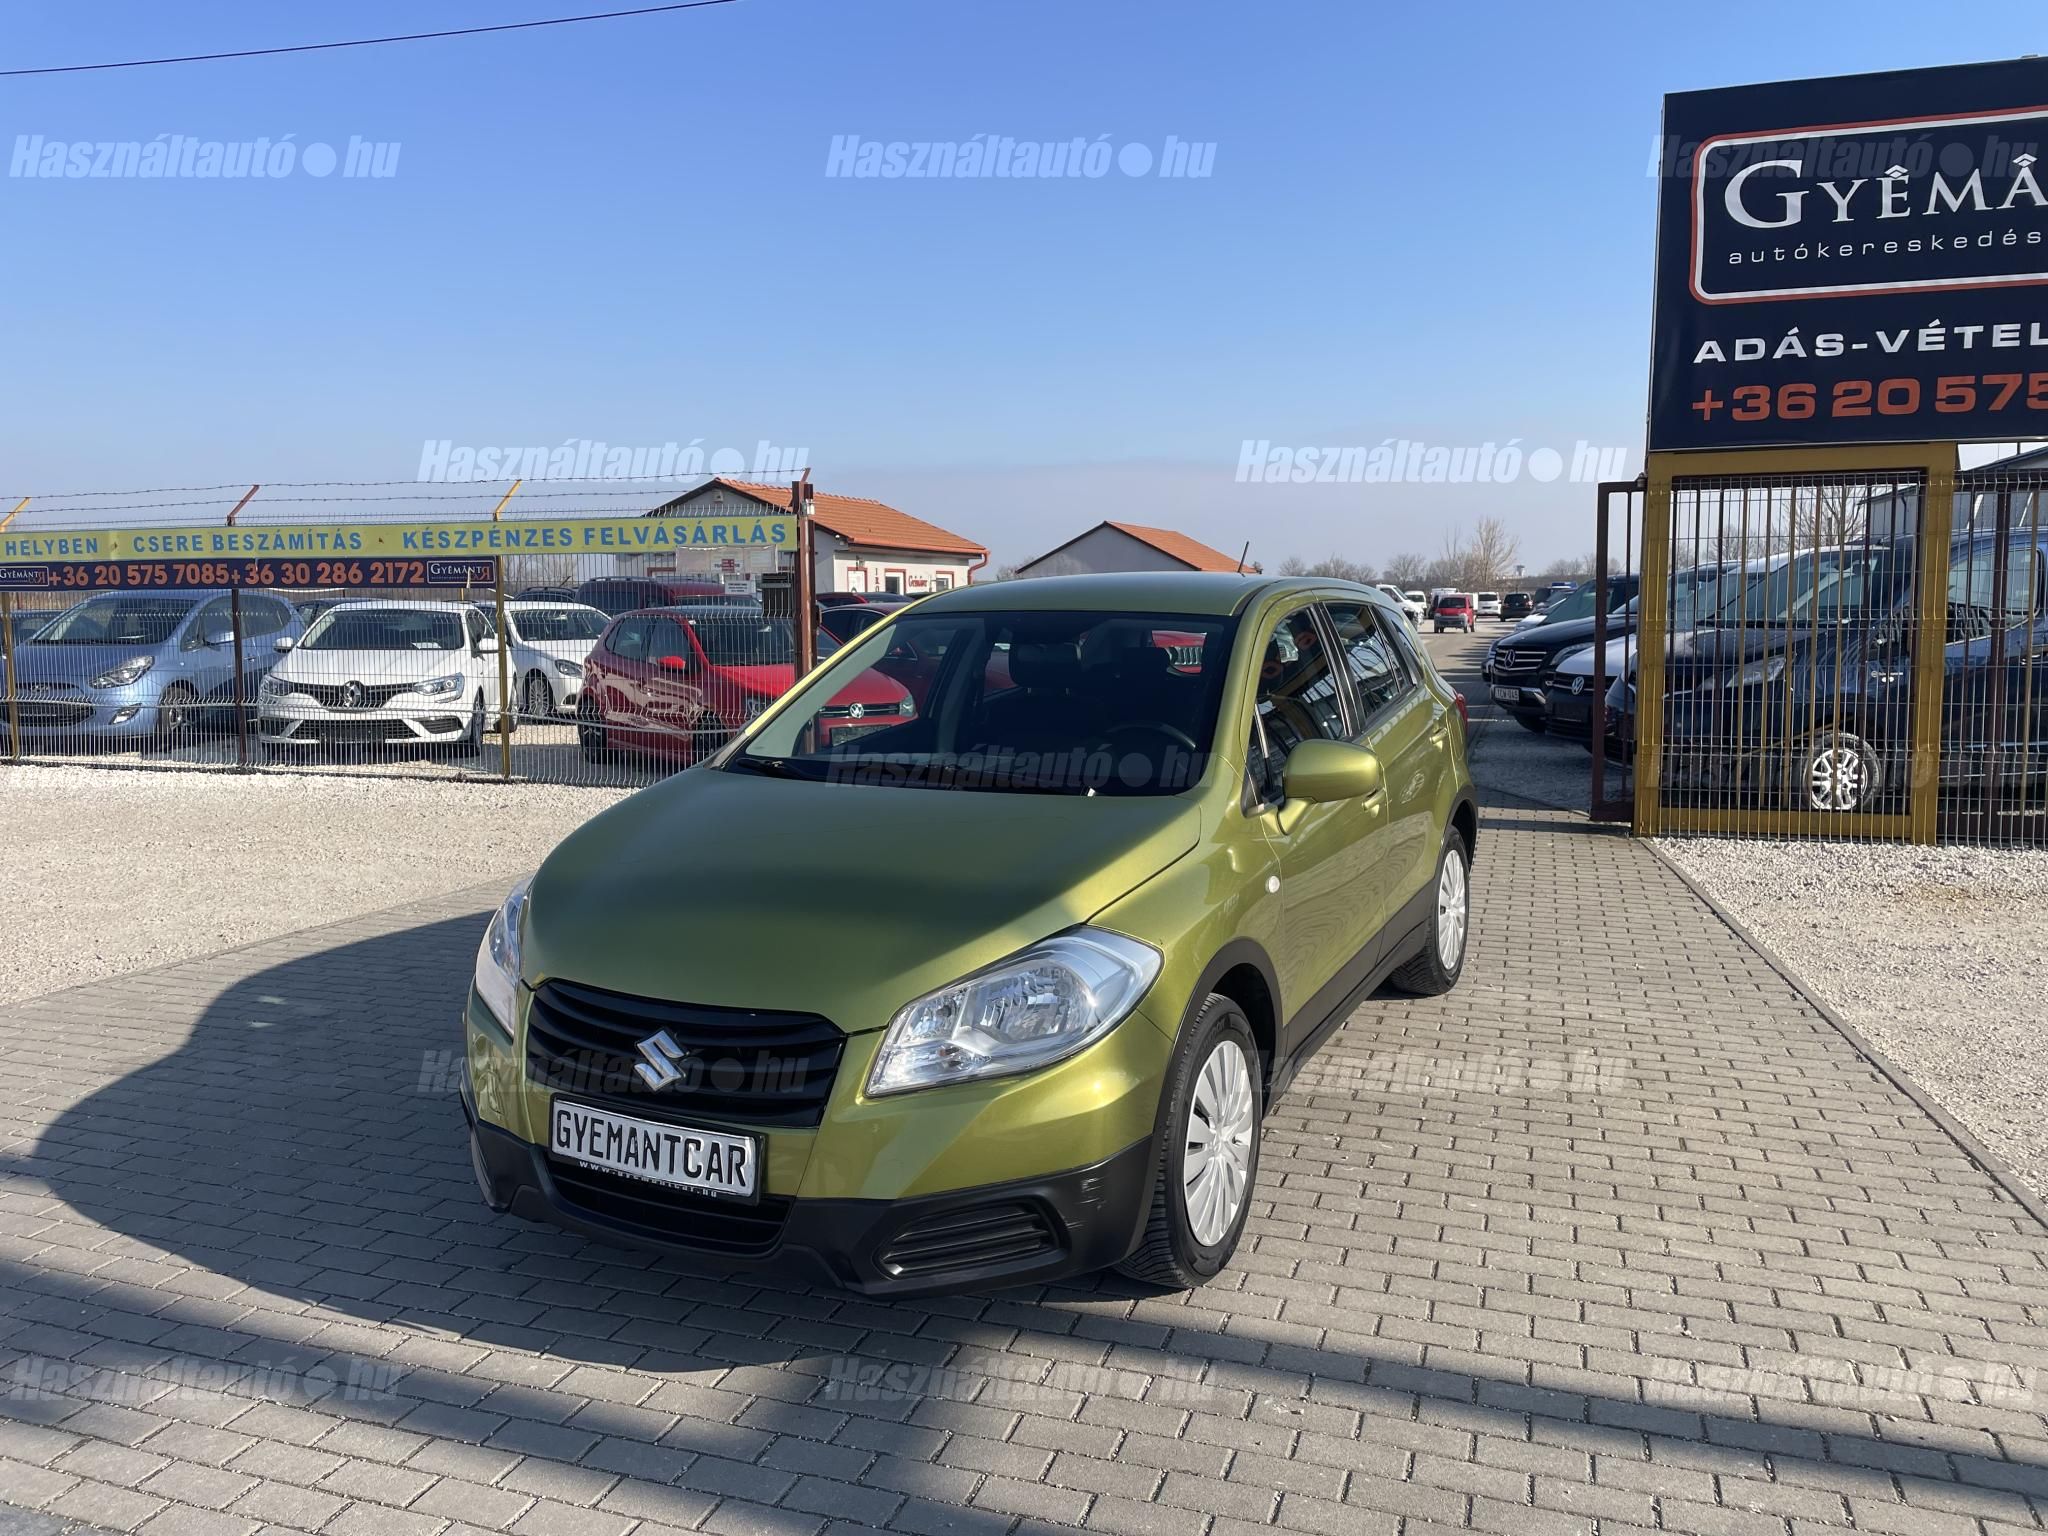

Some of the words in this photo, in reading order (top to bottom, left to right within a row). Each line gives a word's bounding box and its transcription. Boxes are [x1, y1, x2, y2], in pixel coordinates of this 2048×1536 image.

[1729, 228, 2041, 264] autókereskedés
[1693, 318, 2048, 364] ADÁS-VÉTEL
[1692, 382, 1816, 421] +36
[1832, 377, 1921, 418] 20
[5, 537, 99, 556] HELYBEN
[132, 533, 203, 553] CSERE
[212, 527, 363, 551] BESZÁMÍTÁS
[402, 524, 574, 550] KÉSZPÉNZES
[584, 519, 787, 546] FELVÁSÁRLÁS
[94, 565, 121, 585] 20
[127, 564, 168, 585] 575
[175, 563, 229, 585] 7085
[281, 562, 310, 584] 30
[317, 561, 363, 584] 286
[370, 560, 424, 583] 2172
[556, 1109, 746, 1187] GYEMANTCAR
